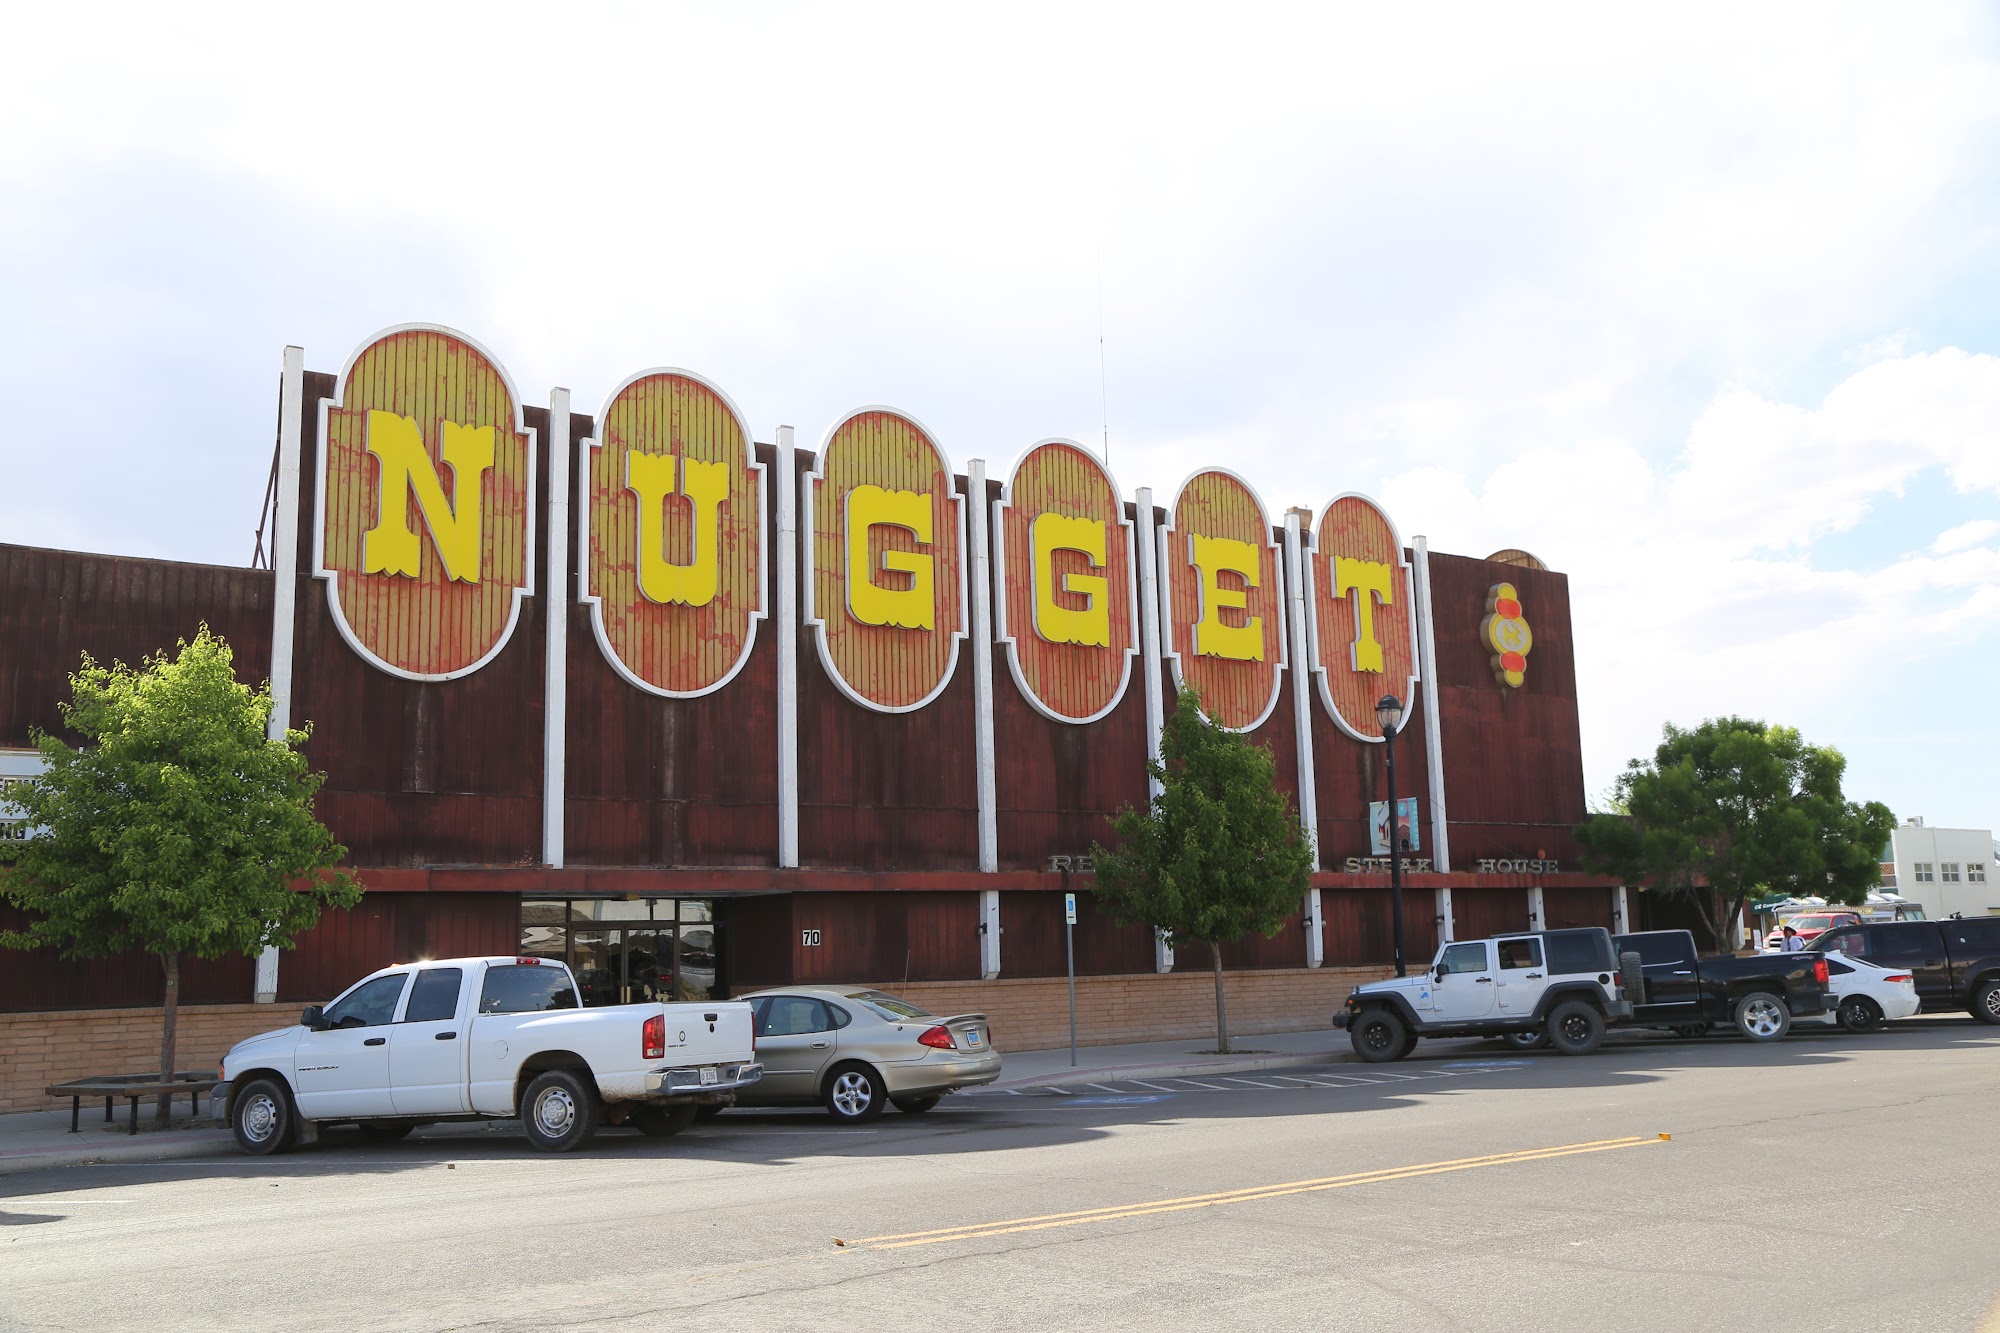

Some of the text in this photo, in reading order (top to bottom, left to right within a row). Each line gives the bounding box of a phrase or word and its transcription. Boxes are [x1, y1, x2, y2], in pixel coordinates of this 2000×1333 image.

[361, 408, 1395, 675] NUGGET
[1345, 857, 1432, 873] STEAK
[1476, 858, 1559, 874] HOUSE
[803, 931, 820, 945] 70
